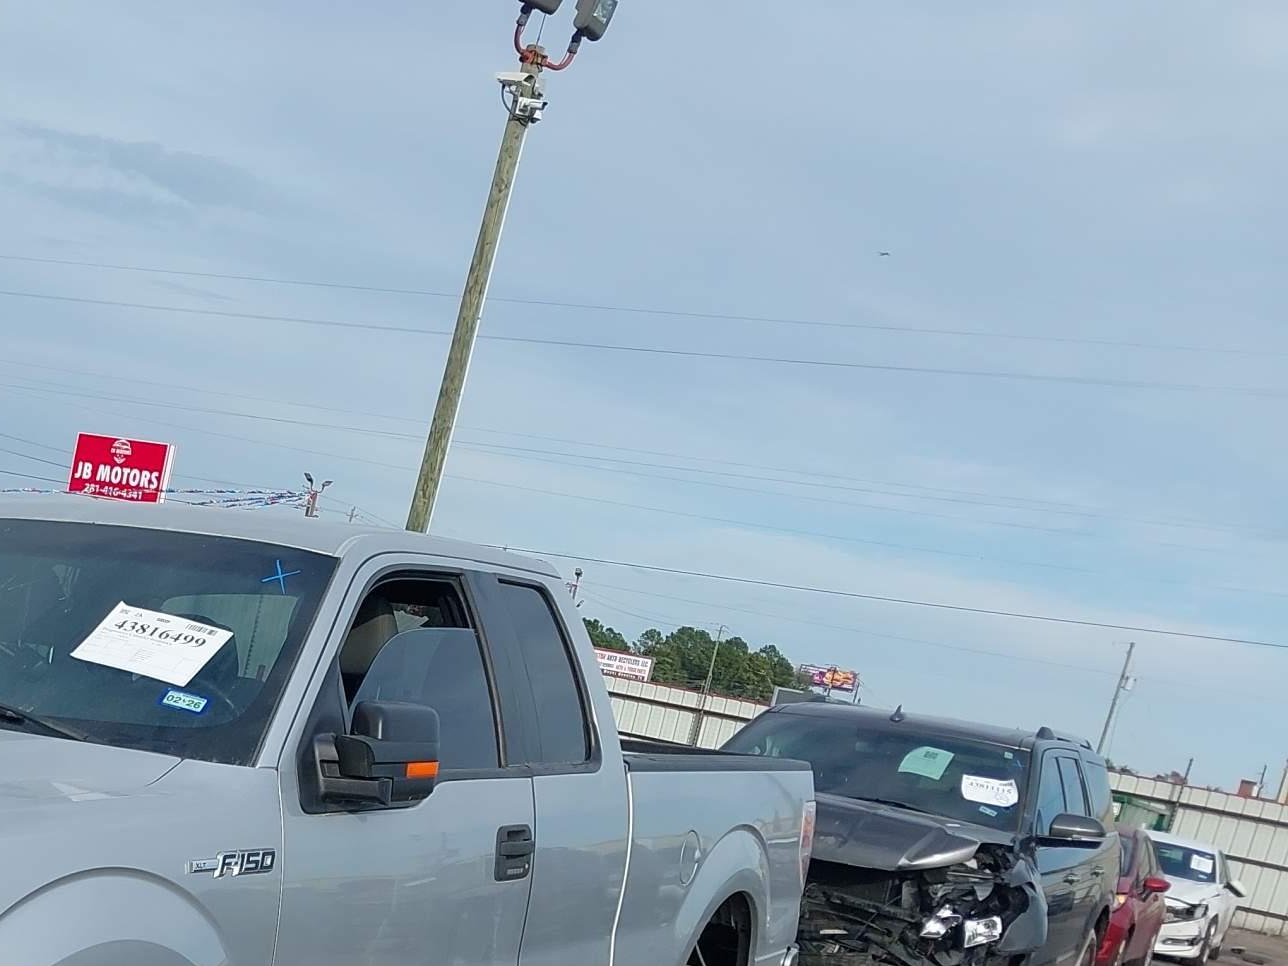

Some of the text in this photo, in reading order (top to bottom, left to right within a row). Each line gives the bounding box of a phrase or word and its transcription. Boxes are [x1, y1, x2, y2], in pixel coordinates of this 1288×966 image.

[74, 461, 159, 490] JB MOTORS
[115, 620, 207, 648] 43816499
